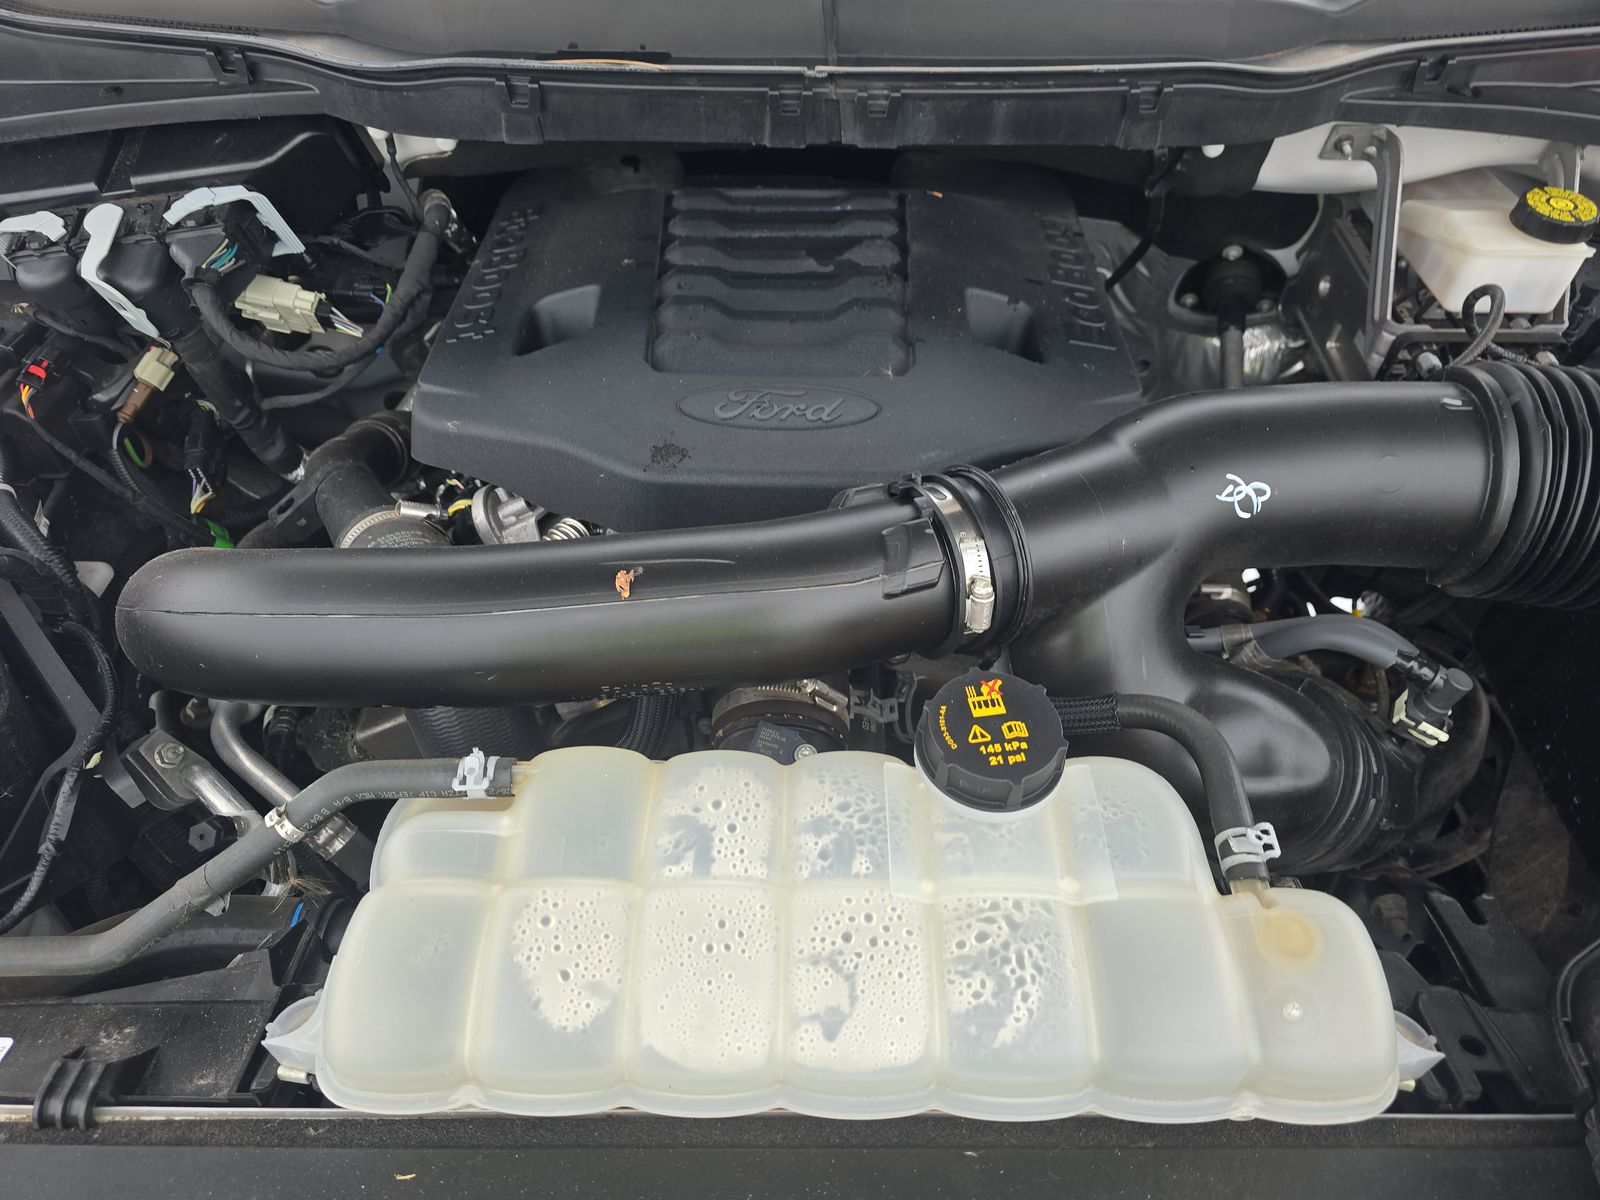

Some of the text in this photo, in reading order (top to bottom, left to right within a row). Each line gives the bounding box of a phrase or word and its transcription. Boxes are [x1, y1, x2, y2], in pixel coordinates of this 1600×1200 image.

[713, 388, 846, 424] Ford
[979, 741, 1028, 755] 145 kPa
[988, 752, 1026, 766] 21 psi
